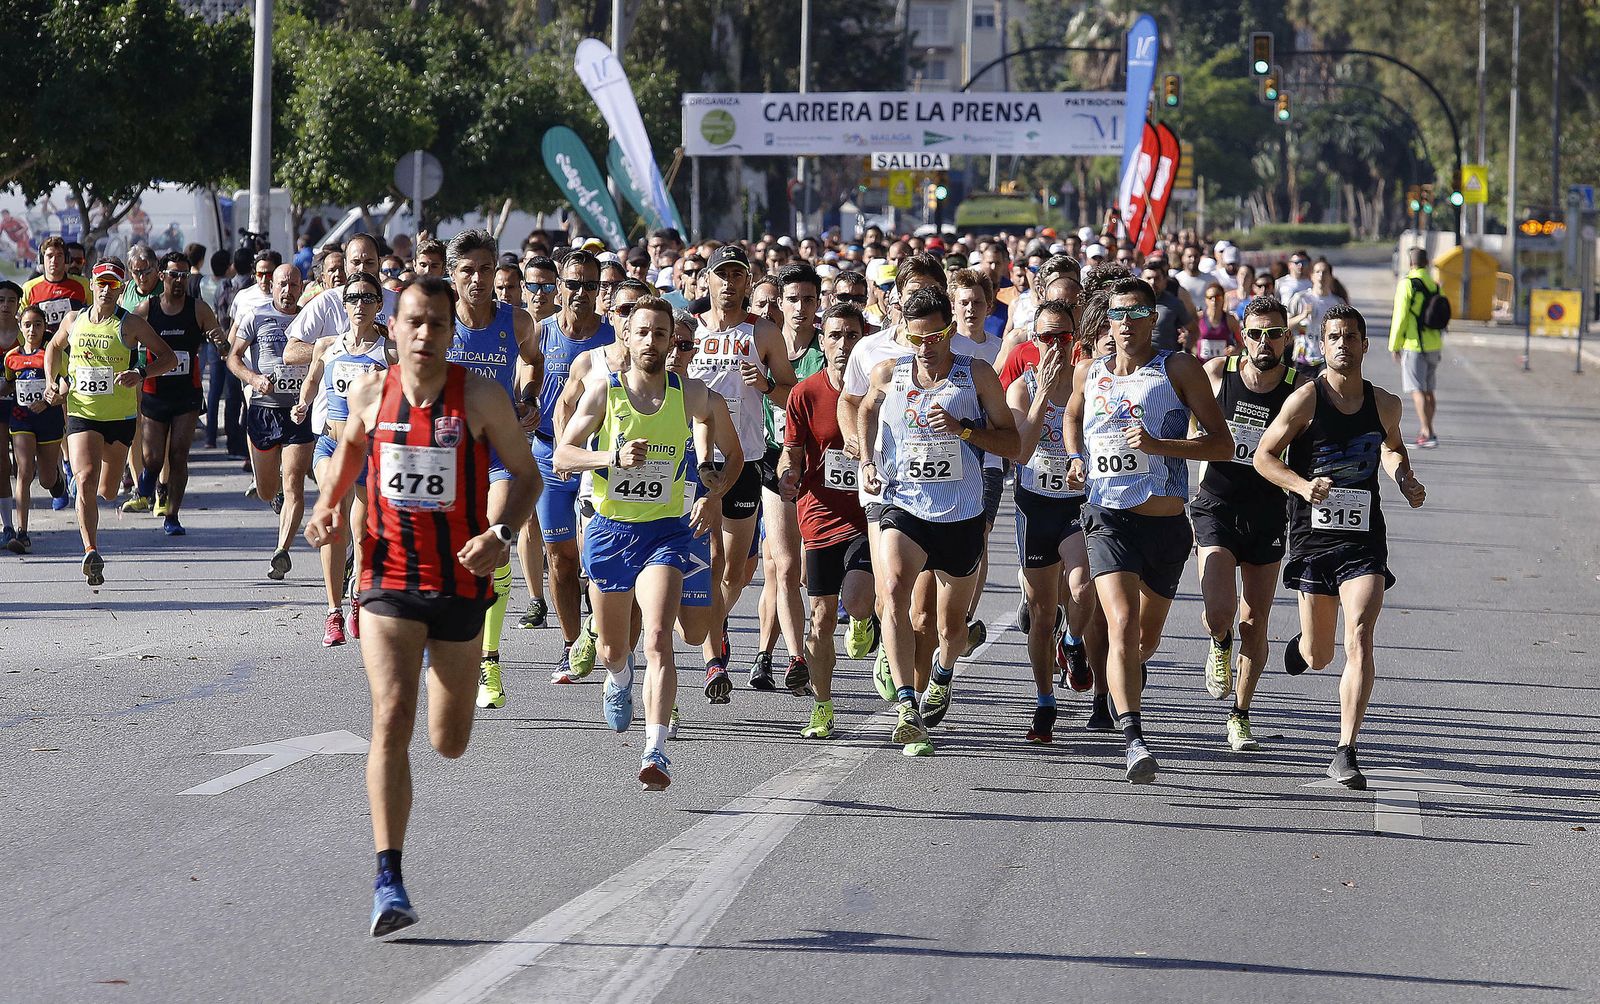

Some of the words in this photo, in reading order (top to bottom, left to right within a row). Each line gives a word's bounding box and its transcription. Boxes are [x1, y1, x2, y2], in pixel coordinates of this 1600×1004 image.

[690, 97, 740, 106] ORGANIZA
[763, 101, 872, 122] CARRERA
[879, 101, 909, 122] DE
[916, 102, 944, 122] LA
[952, 101, 1042, 122] PRENSA
[877, 154, 944, 168] SALIDA
[78, 338, 110, 350] DAVID
[80, 380, 108, 393] 283
[19, 391, 43, 403] 549
[1235, 405, 1270, 420] BESOCCER
[909, 460, 952, 478] 552
[1097, 453, 1138, 474] 803
[388, 472, 444, 496] 478
[830, 469, 856, 487] 56
[1038, 472, 1064, 491] 15
[614, 479, 663, 499] 449
[734, 501, 755, 509] Joma
[1317, 507, 1362, 526] 315
